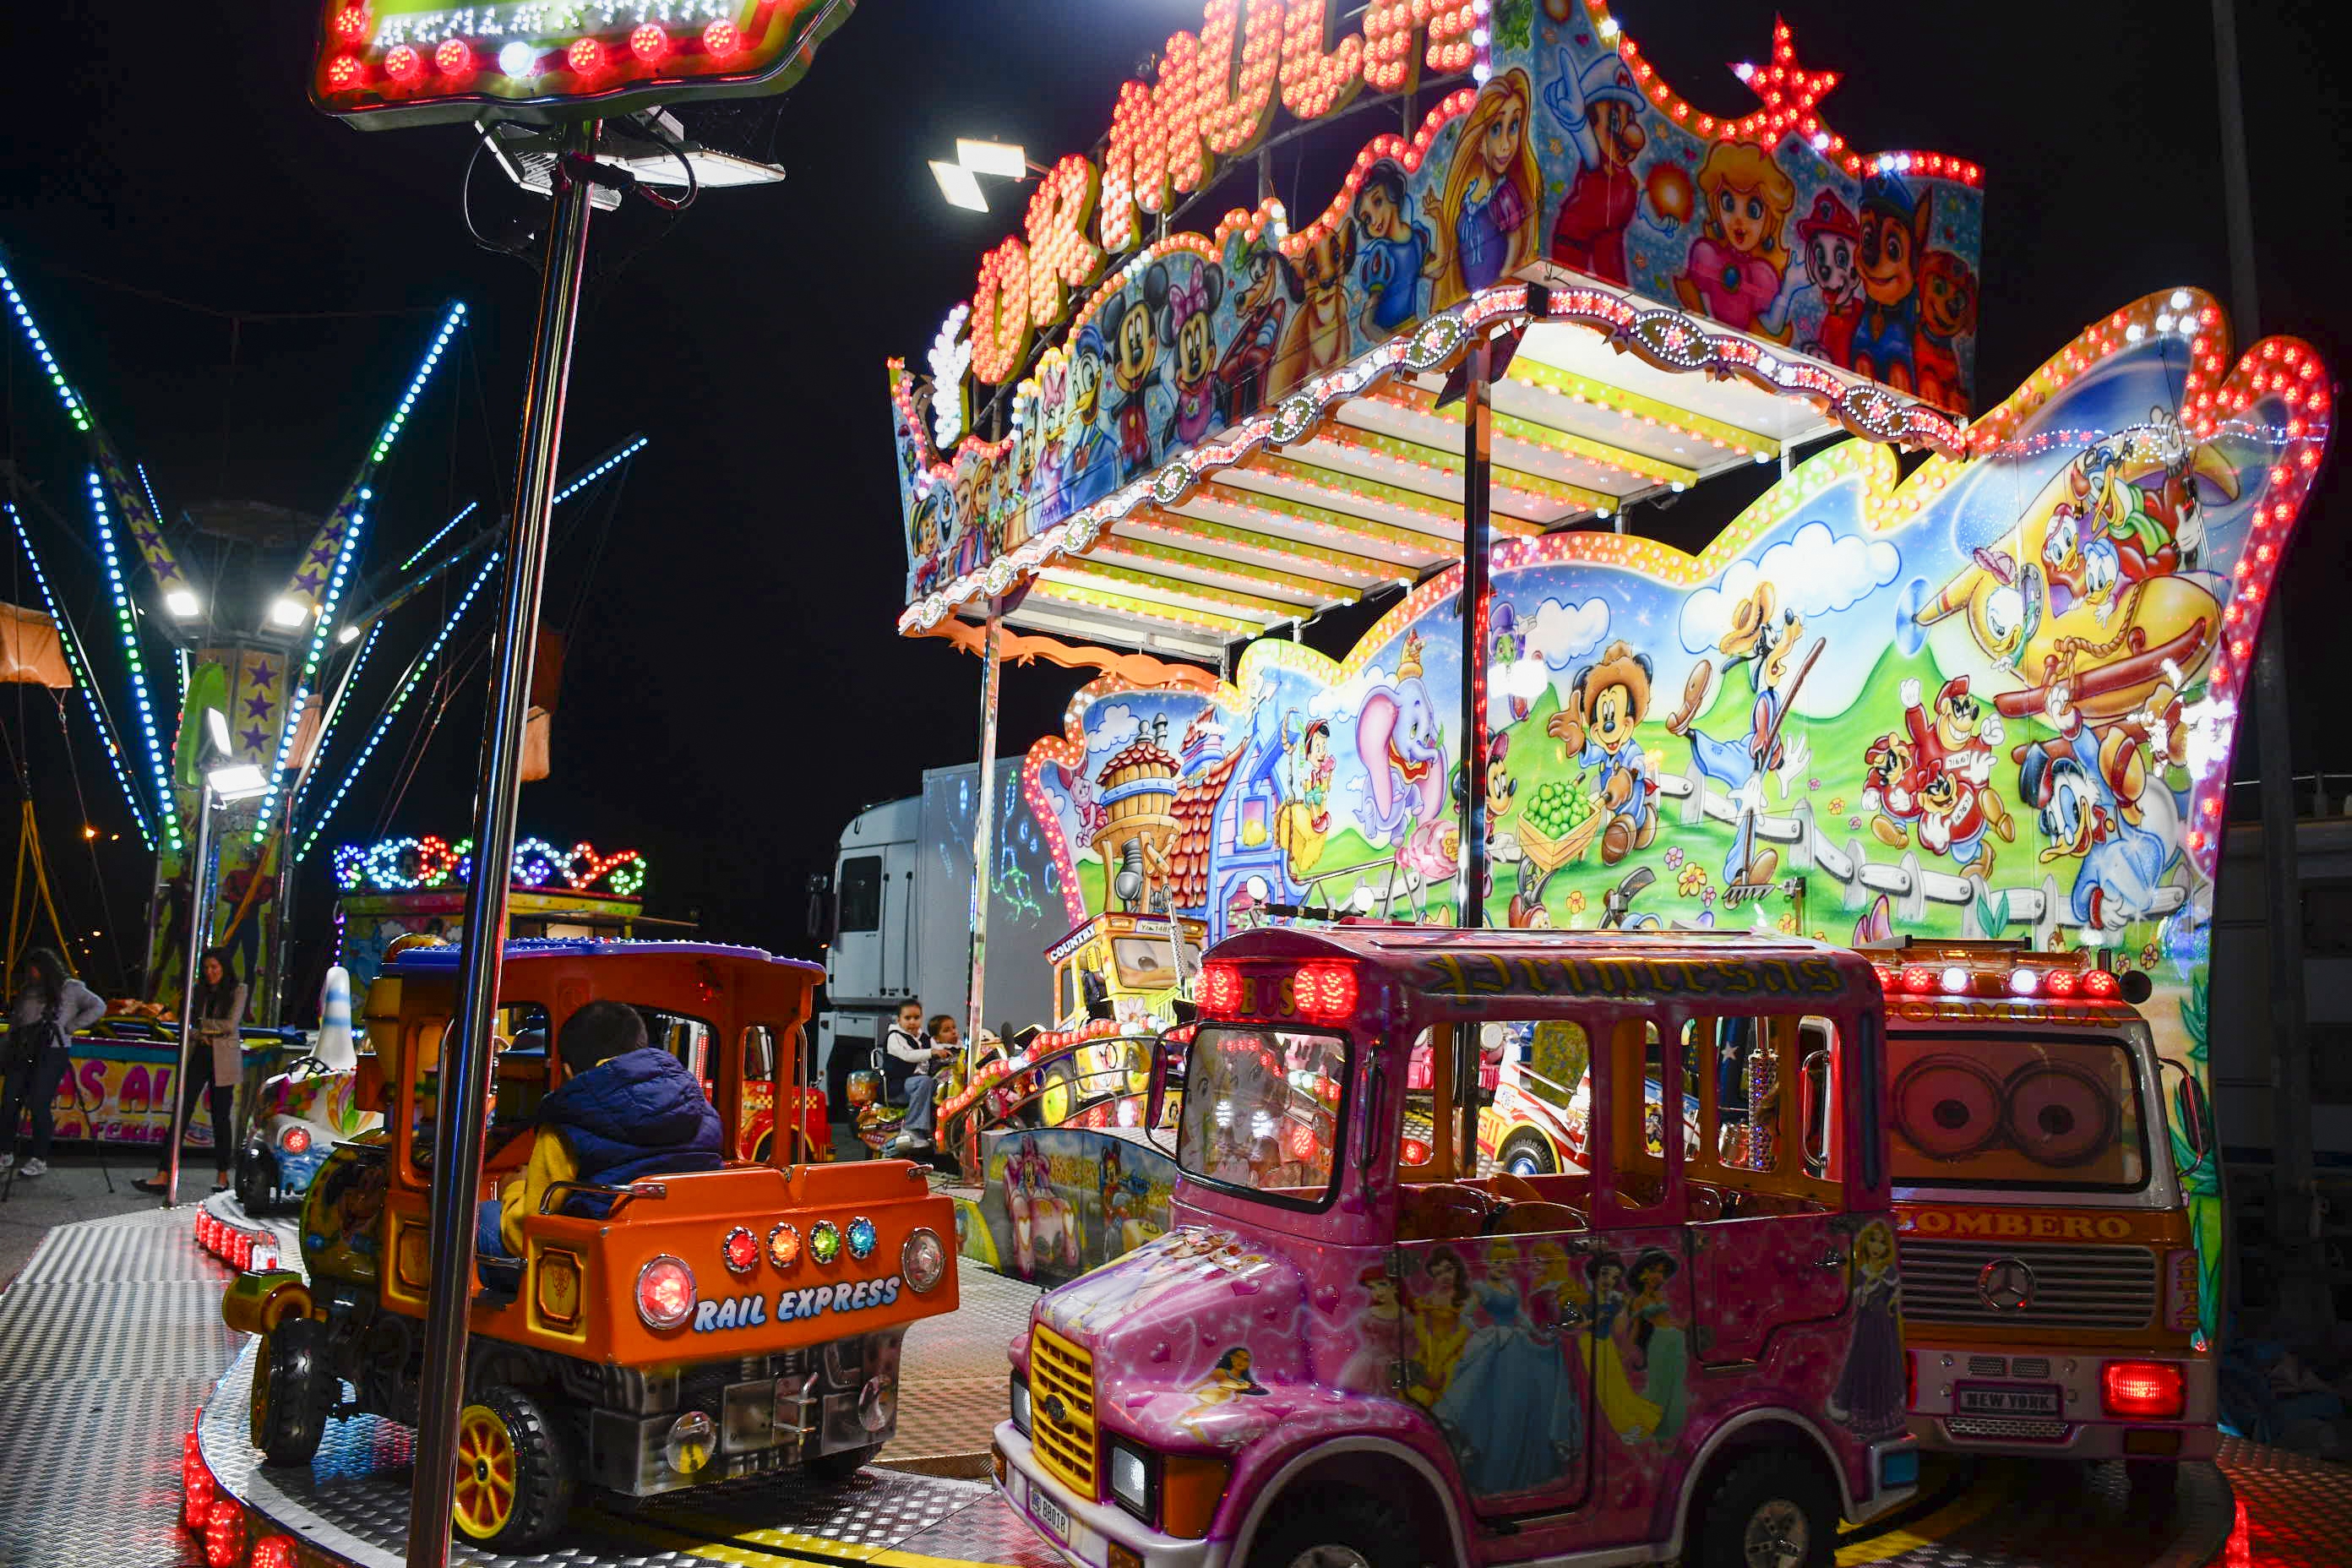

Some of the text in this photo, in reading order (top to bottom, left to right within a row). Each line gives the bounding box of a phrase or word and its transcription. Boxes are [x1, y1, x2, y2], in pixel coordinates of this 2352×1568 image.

[1050, 923, 1096, 961] COUNTRY
[1240, 976, 1296, 1016] BUS
[693, 1276, 901, 1333] RAIL EXPRESS
[1967, 1391, 2050, 1409] NEW YORK
